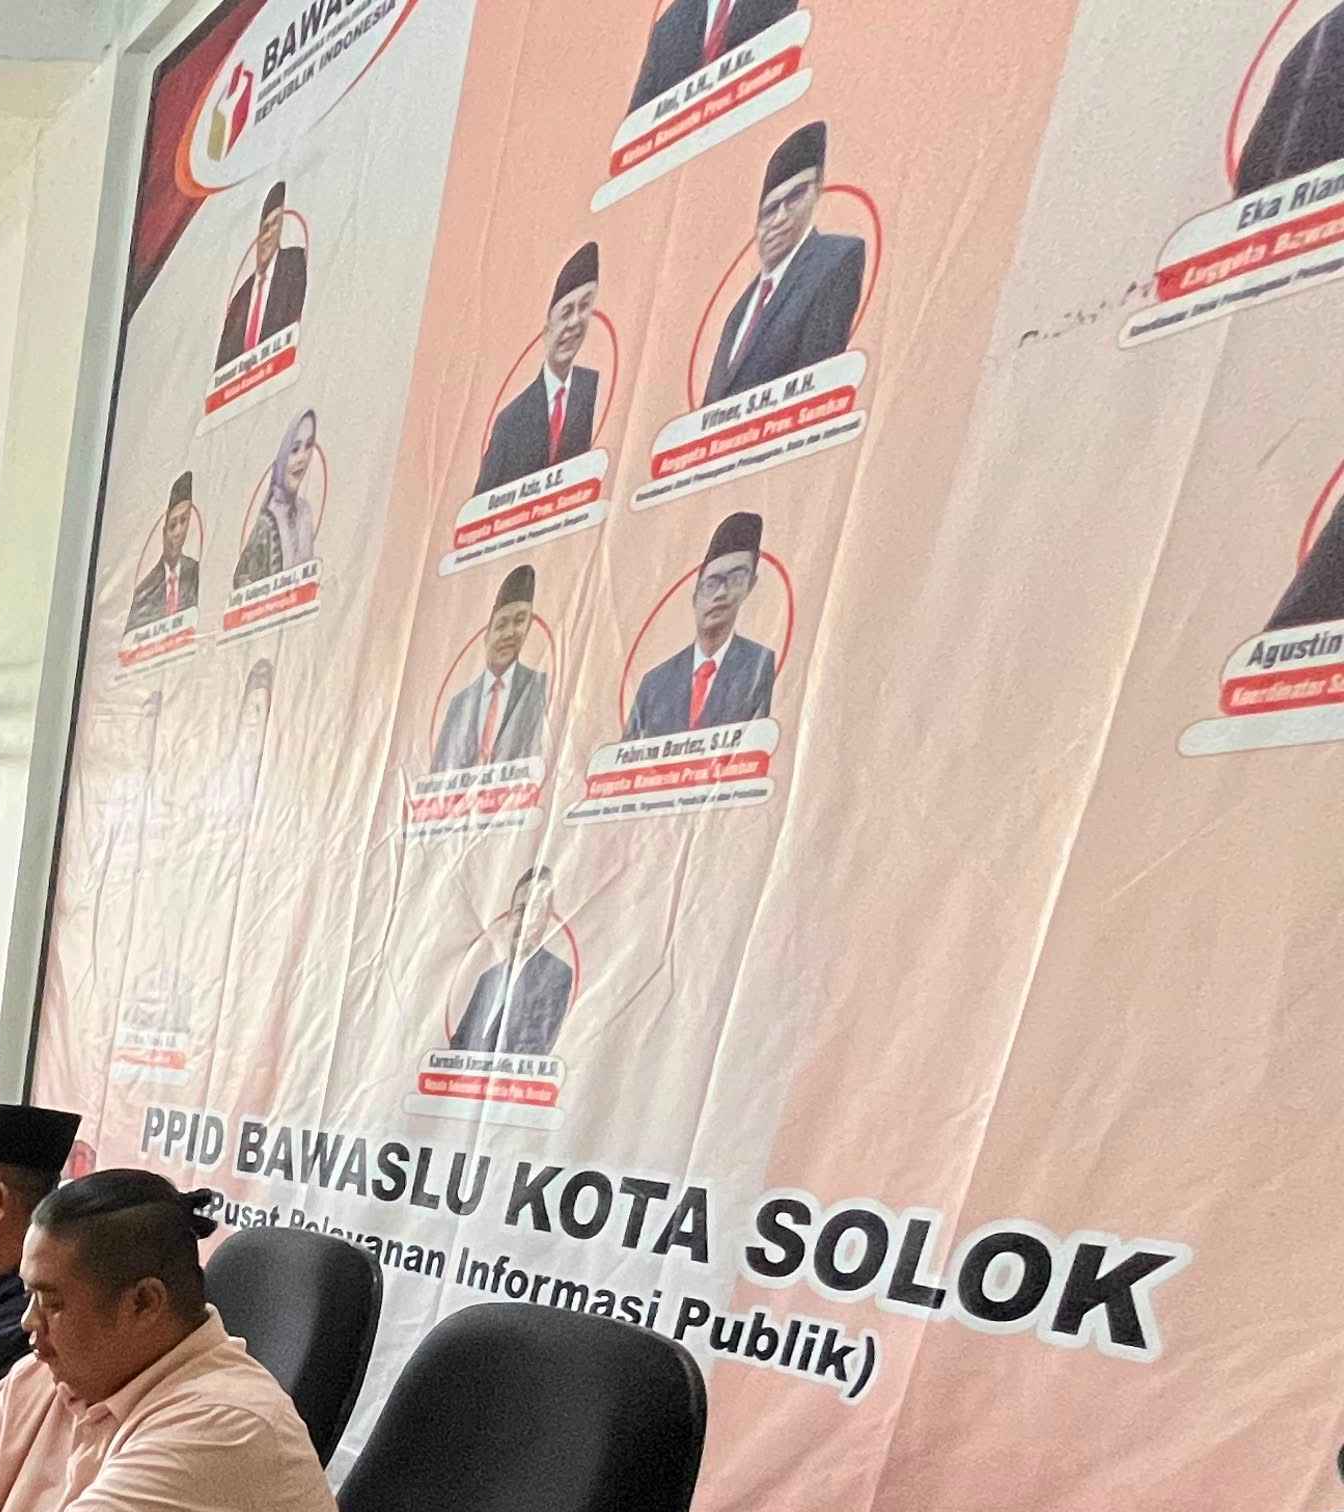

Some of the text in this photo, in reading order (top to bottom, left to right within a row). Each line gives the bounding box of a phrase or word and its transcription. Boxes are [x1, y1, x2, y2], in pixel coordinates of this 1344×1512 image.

[262, 0, 355, 82] BAWA
[254, 62, 315, 126] REPUBLIK
[1237, 195, 1283, 231] Eka
[141, 1106, 1176, 1350] PPID BAWASLU KOTA SOLOK
[455, 1246, 662, 1331] Informasi
[673, 1295, 878, 1398] Publik)
